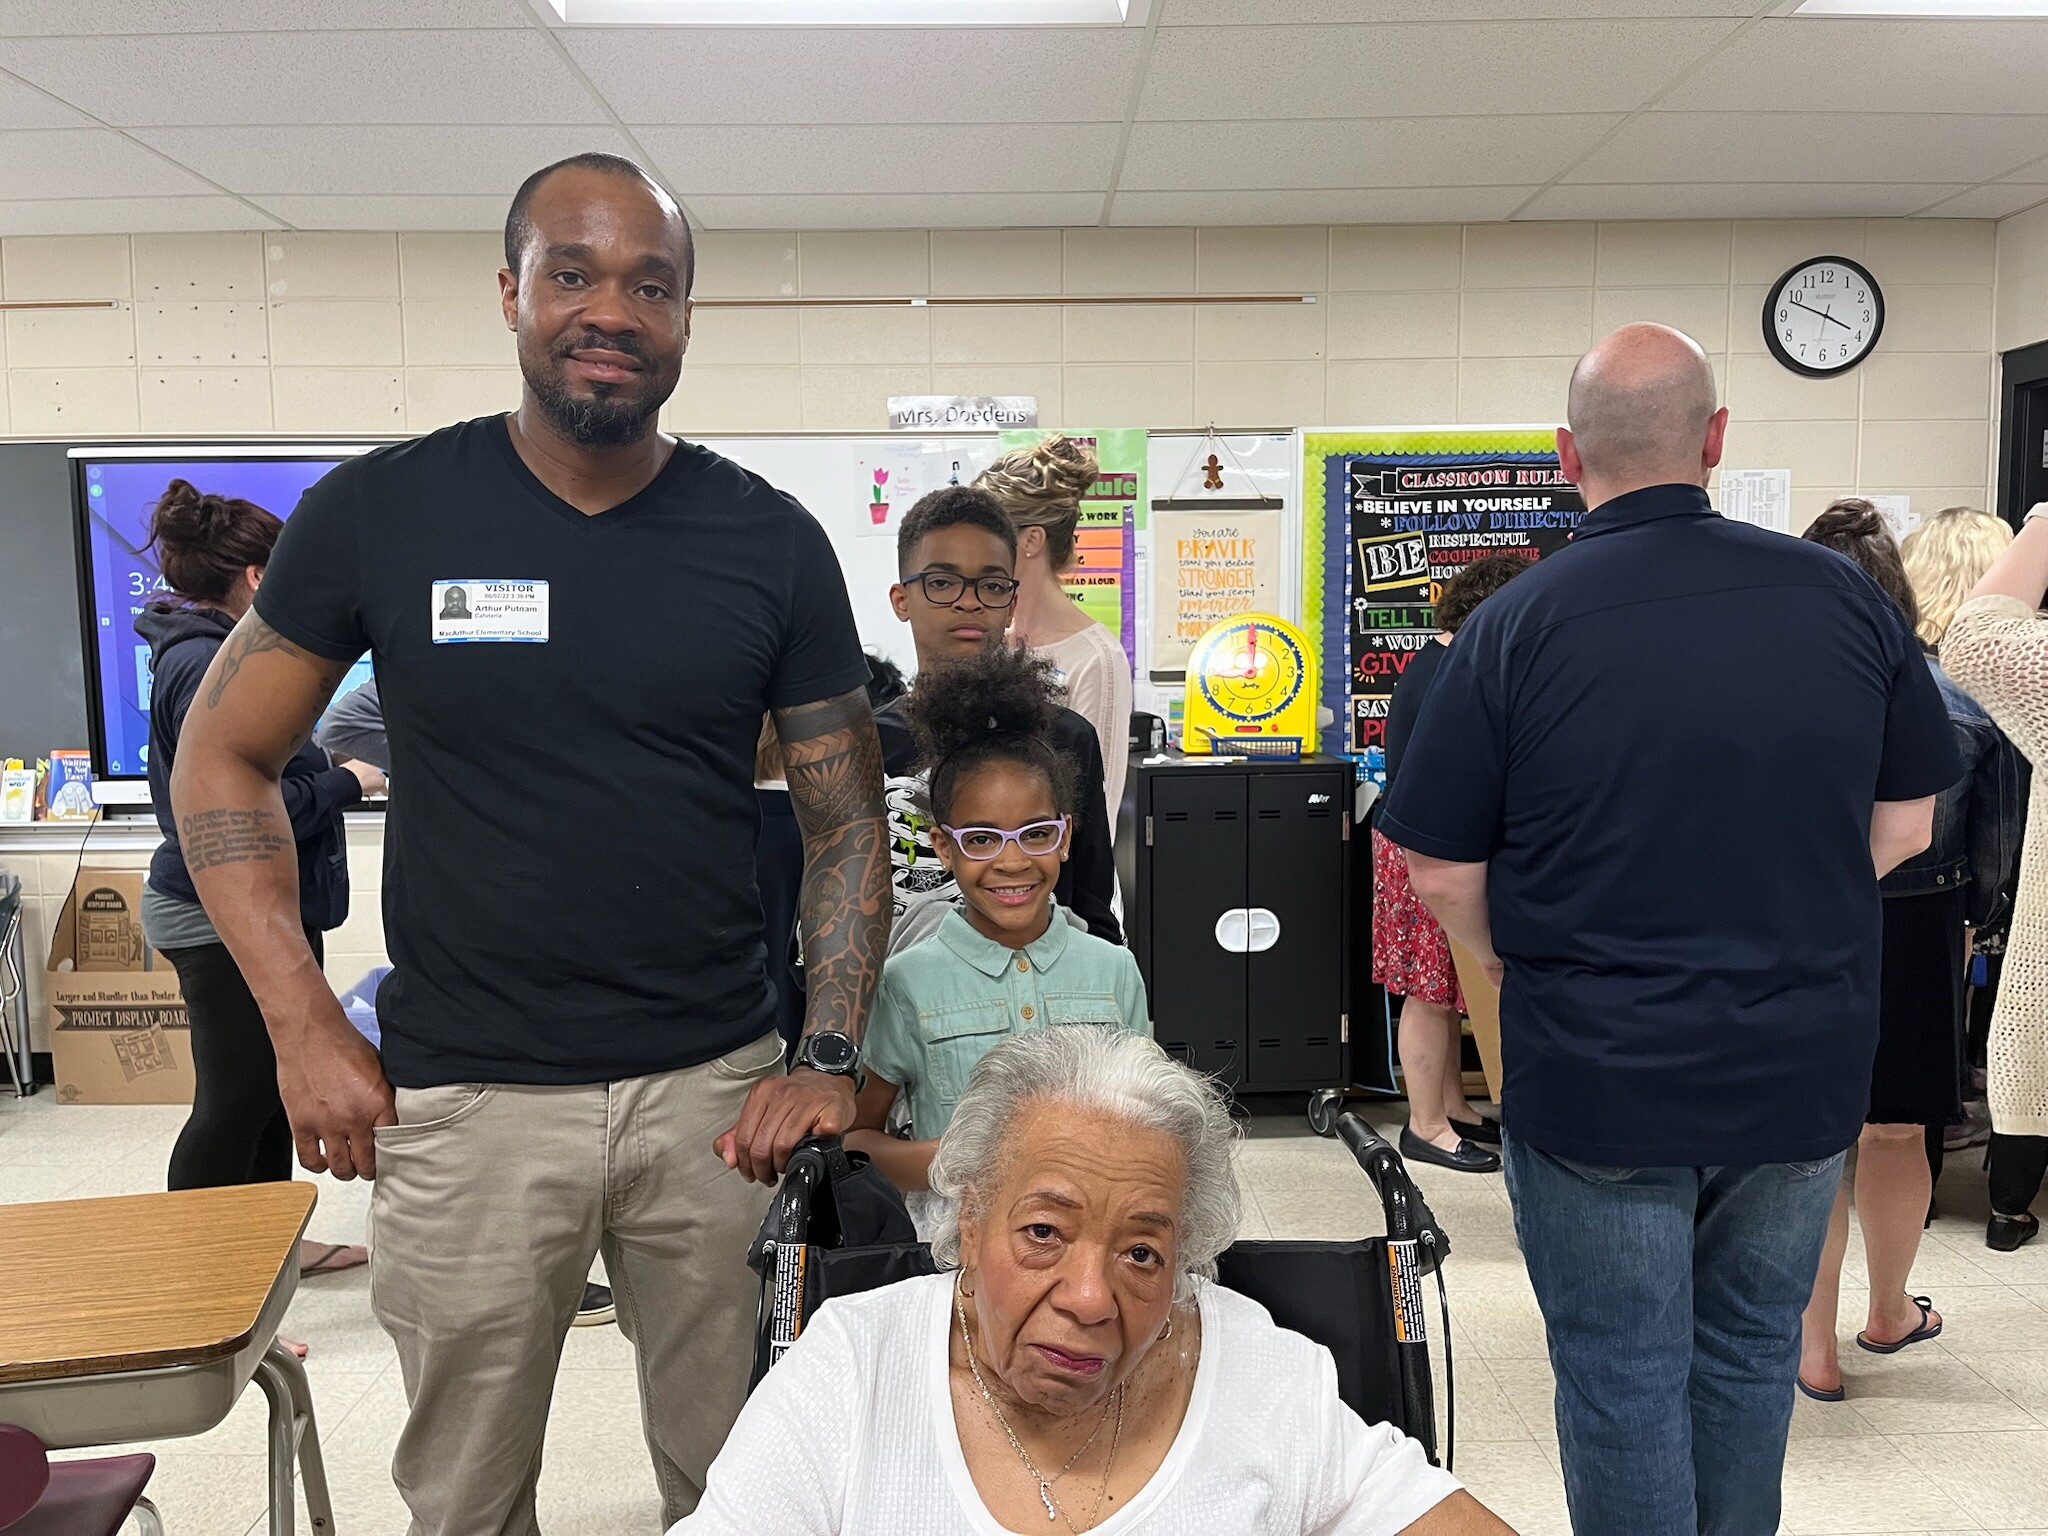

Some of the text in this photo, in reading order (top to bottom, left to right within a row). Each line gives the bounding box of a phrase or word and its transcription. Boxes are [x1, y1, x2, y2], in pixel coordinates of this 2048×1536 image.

[1803, 275, 1816, 288] 11
[1820, 270, 1834, 283] 12
[1845, 276, 1850, 288] 1
[1789, 290, 1803, 303] 10
[1857, 290, 1865, 303] 2
[1780, 309, 1788, 322] 9
[1862, 310, 1870, 323] 3
[1785, 328, 1793, 342] 8
[1855, 330, 1861, 342] 4
[1799, 344, 1807, 356] 7
[1819, 349, 1826, 362] 6
[1840, 344, 1847, 357] 5
[898, 406, 1026, 423] Mrs. Doedens
[1401, 469, 1510, 488] CLASSROOM
[1363, 497, 1552, 514] BELIEVE IN YOURSELF
[1087, 512, 1118, 521] WORK
[1393, 513, 1482, 532] FOLLOW
[1429, 532, 1530, 549] RESPECTFUL
[1177, 539, 1255, 559] BRAVER
[1366, 539, 1426, 580] BE
[1178, 568, 1254, 590] STRONGER
[485, 584, 534, 592] VISITOR
[504, 605, 538, 613] Putnam
[1367, 609, 1414, 628] TELL
[1282, 648, 1290, 660] 2
[1287, 667, 1295, 678] 3
[1212, 684, 1220, 696] 8
[1280, 686, 1288, 695] 4
[1228, 698, 1235, 709] 7
[1245, 703, 1253, 714] 6
[1264, 698, 1272, 710] 5
[56, 991, 80, 1003] Larger
[83, 992, 96, 1001] and
[98, 992, 128, 1001] Sturdier
[131, 991, 148, 1001] than
[151, 990, 175, 1001] Poster
[72, 1010, 112, 1026] PROJECT
[115, 1010, 155, 1026] DISPLAY
[1391, 1265, 1402, 1310] WARNING
